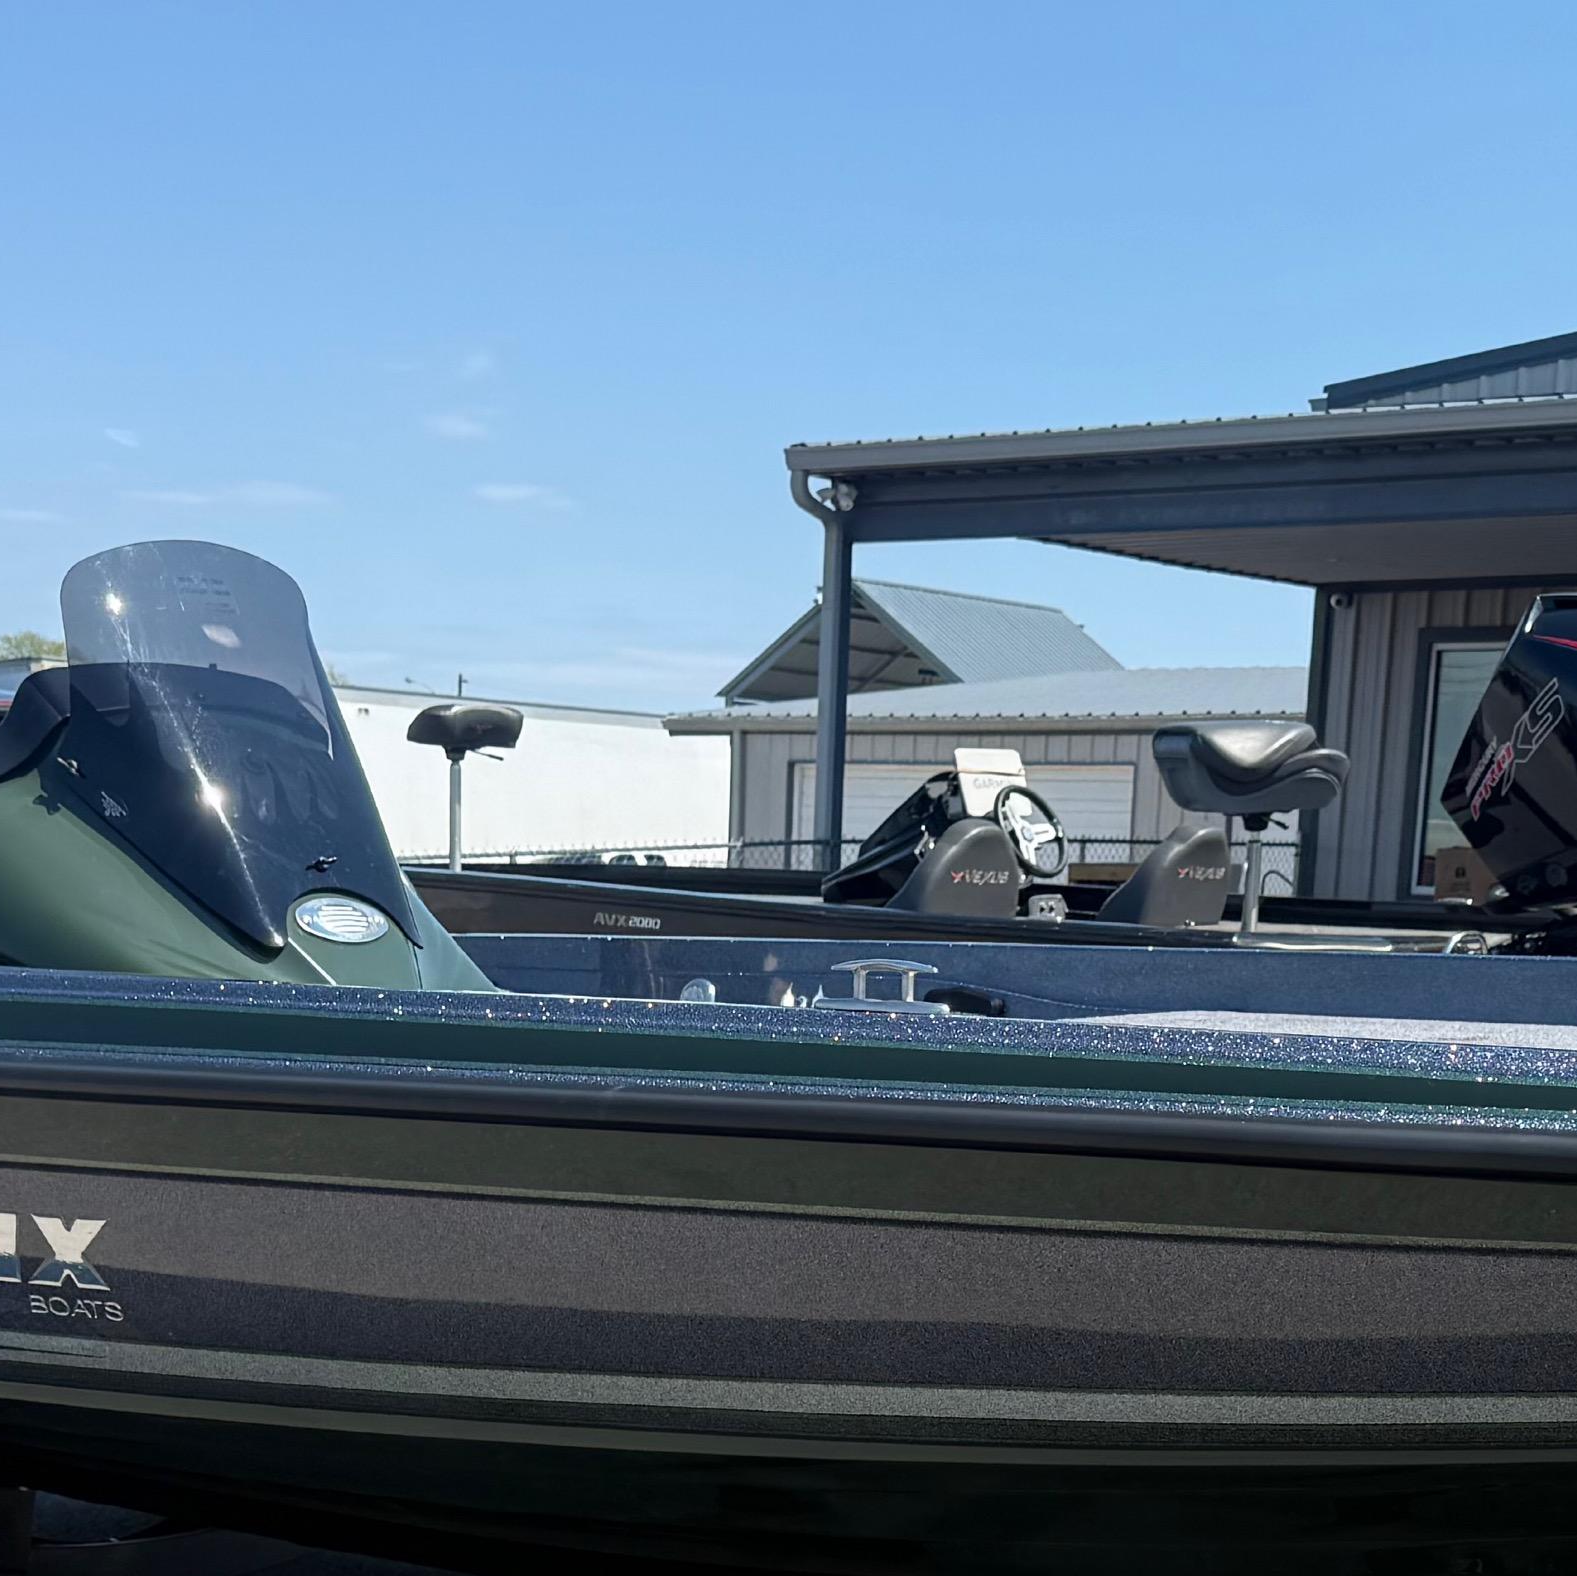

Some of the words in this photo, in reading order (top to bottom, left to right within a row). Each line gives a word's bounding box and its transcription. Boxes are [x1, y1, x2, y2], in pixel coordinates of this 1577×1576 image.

[593, 912, 627, 928] AVX
[628, 915, 661, 930] 2000
[29, 1294, 124, 1322] BOATS
